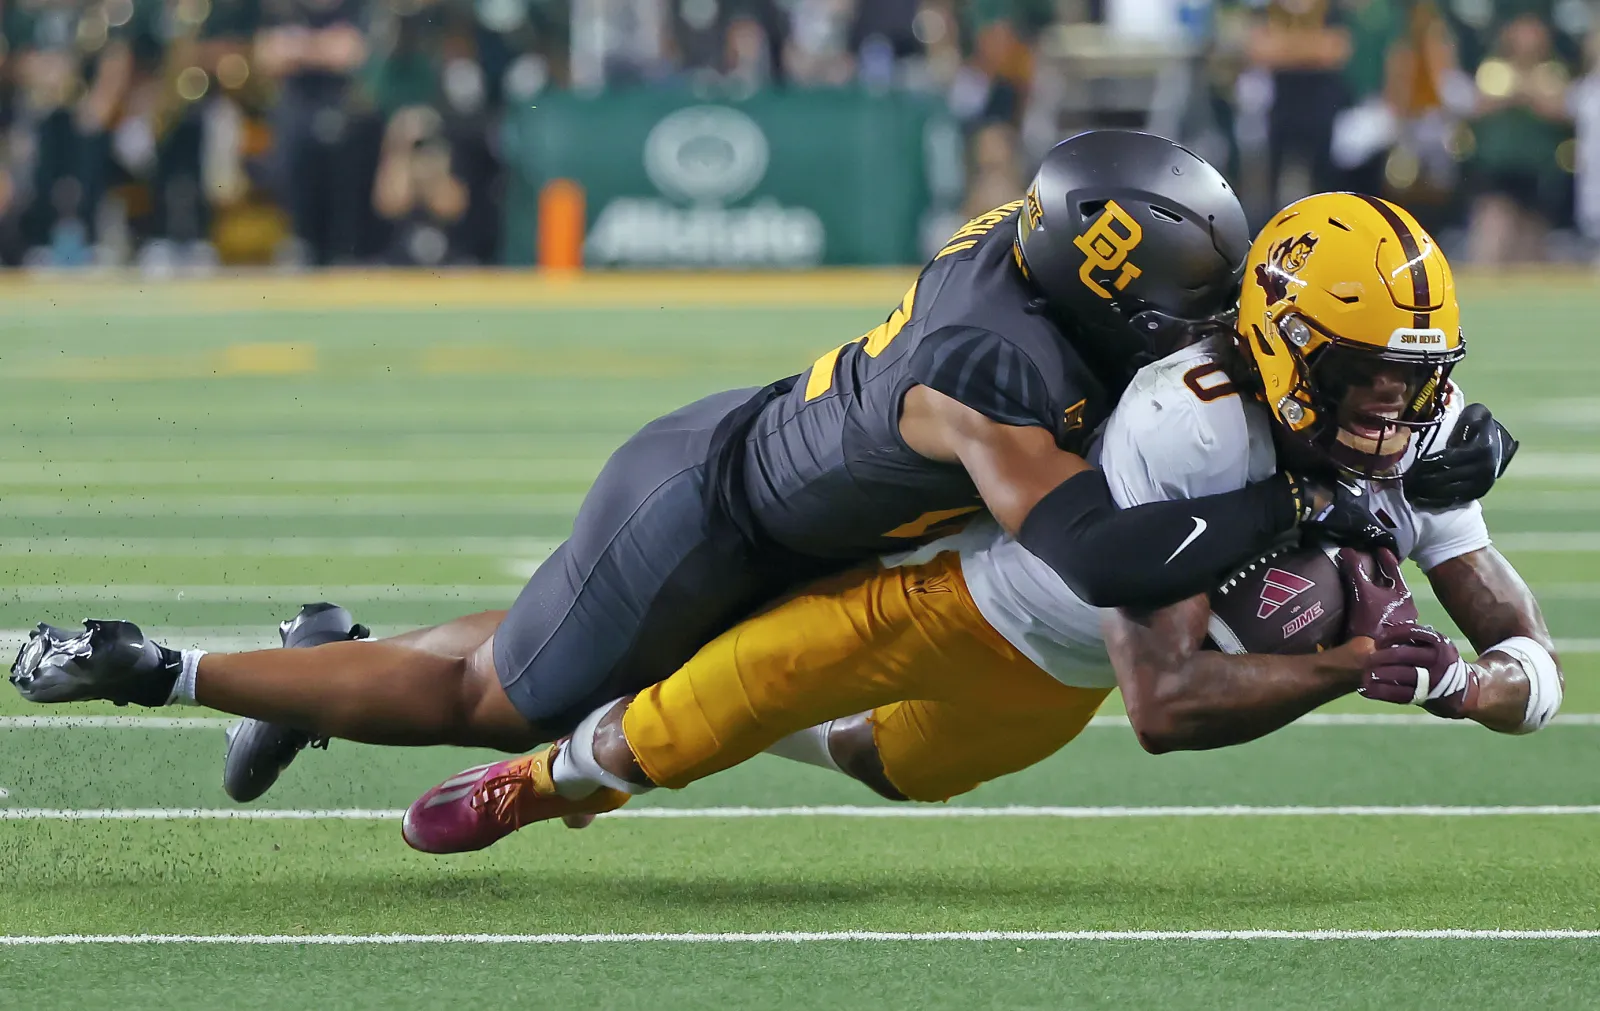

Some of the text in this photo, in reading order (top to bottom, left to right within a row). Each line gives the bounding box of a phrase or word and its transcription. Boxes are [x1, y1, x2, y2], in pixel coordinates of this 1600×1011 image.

[1400, 334, 1441, 344] SUN DEVILS
[1283, 601, 1324, 639] DIME
